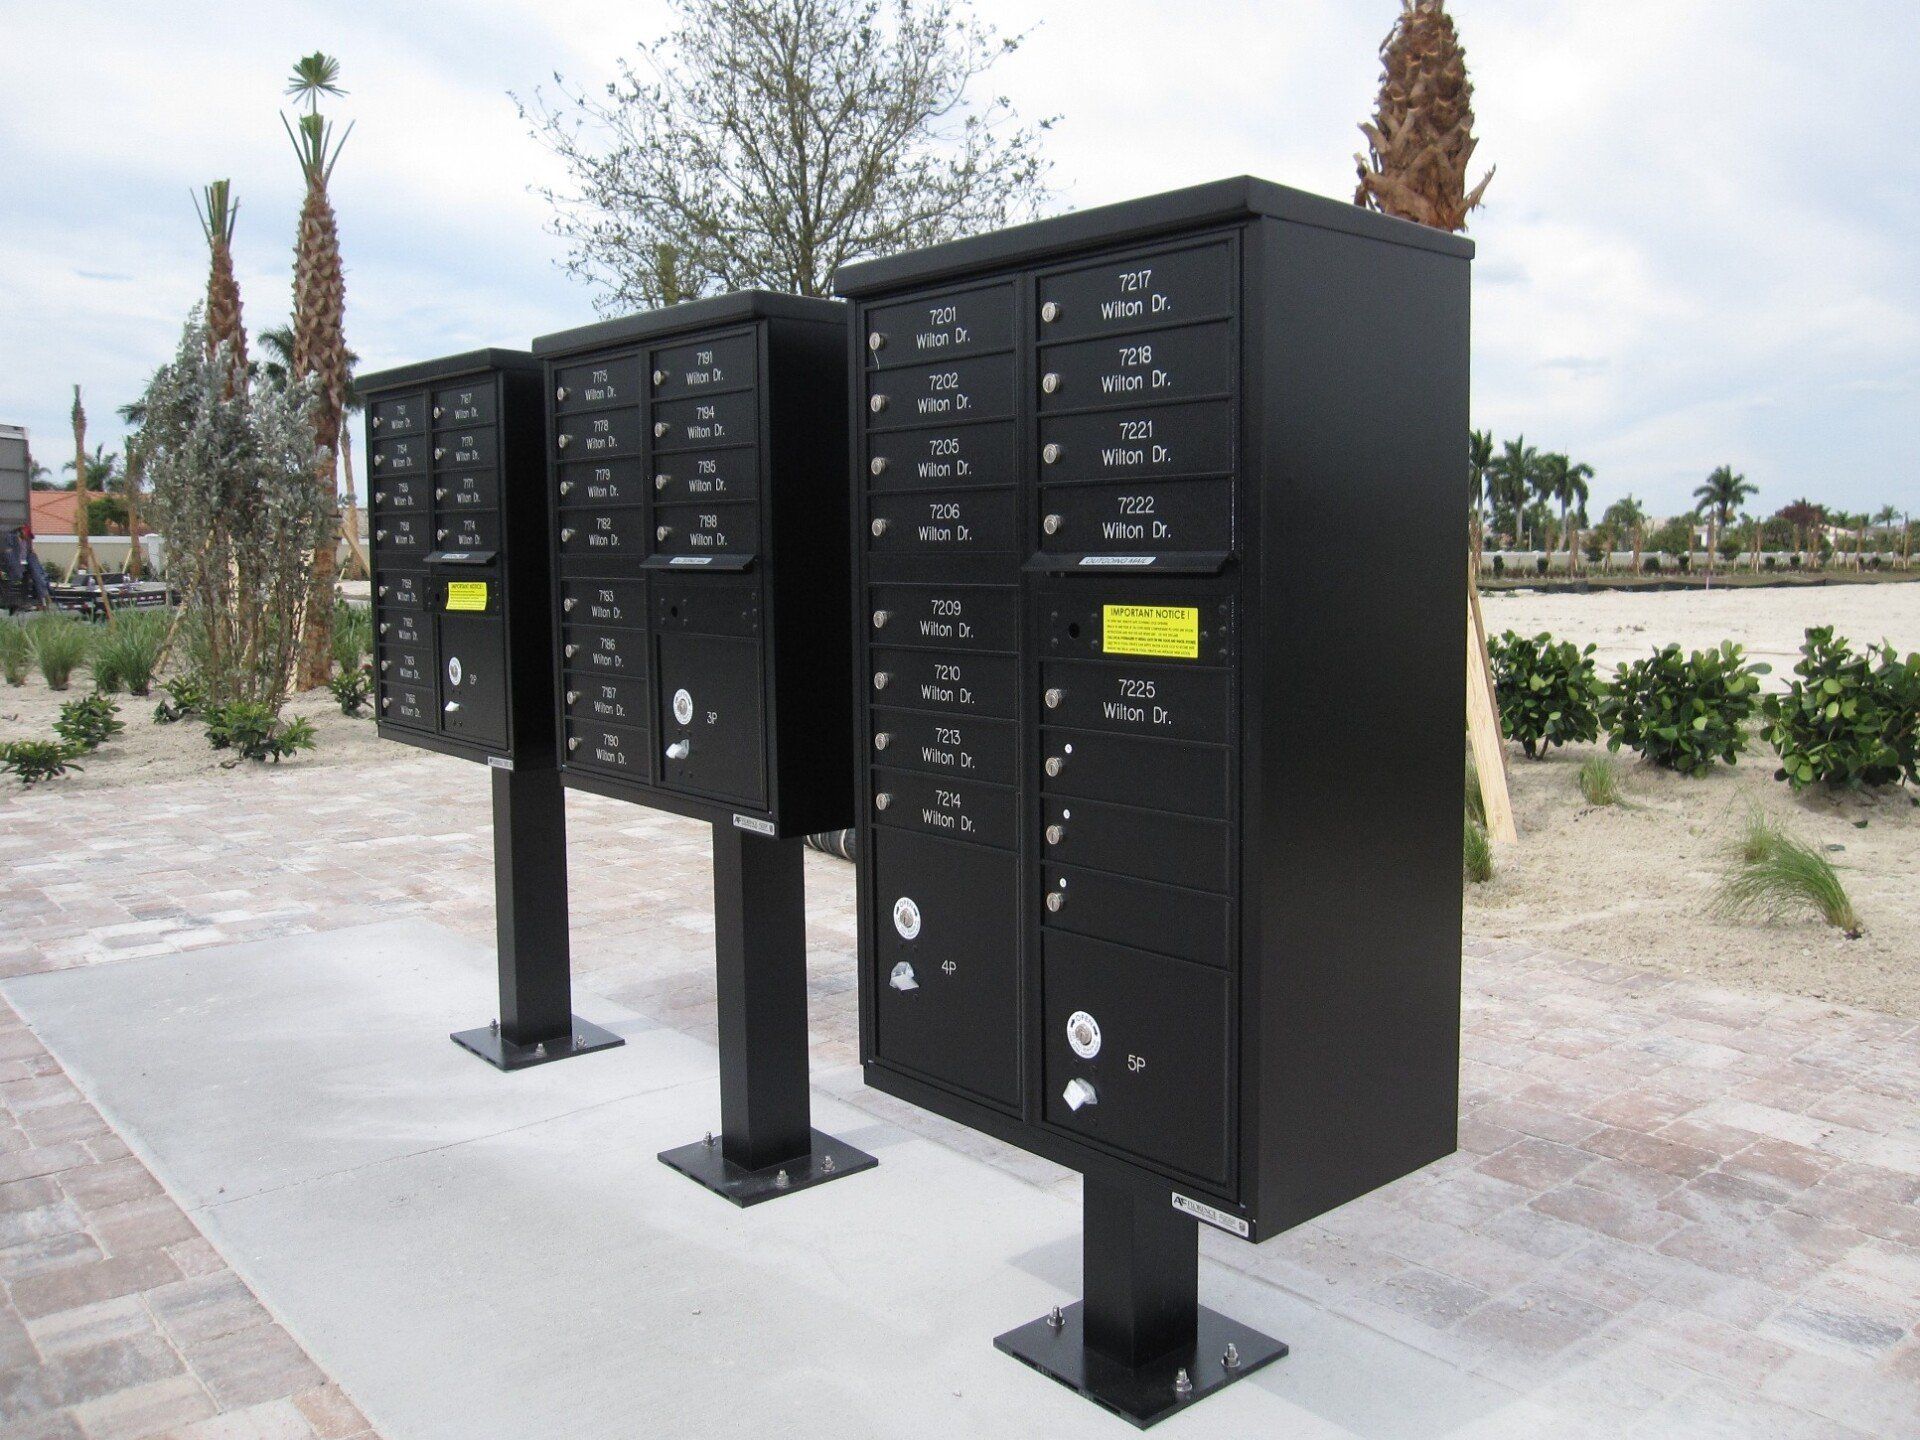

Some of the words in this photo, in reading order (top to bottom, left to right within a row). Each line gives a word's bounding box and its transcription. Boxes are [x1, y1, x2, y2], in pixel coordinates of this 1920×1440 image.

[1119, 270, 1152, 292] 7217
[1101, 300, 1143, 320] Wilton
[1152, 295, 1171, 312] Dr.
[929, 306, 956, 325] 7201
[917, 330, 949, 349] Wilton
[955, 328, 970, 343] Dr.
[697, 351, 712, 365] 7191
[1119, 346, 1152, 367] 7218
[593, 370, 607, 383] 7175
[686, 371, 709, 385] Wilton
[713, 368, 723, 381] Dr.
[929, 372, 958, 390] 7202
[1101, 375, 1143, 394] Wilton
[1152, 370, 1171, 388] Dr.
[585, 389, 604, 400] Wilton
[608, 386, 616, 398] Dr.
[918, 397, 950, 413] Wilton
[957, 394, 971, 410] Dr.
[696, 406, 714, 419] 7194
[594, 420, 608, 432] 7178
[688, 426, 710, 439] Wilton
[714, 424, 725, 436] Dr.
[1119, 421, 1152, 440] 7221
[586, 437, 605, 449] Wilton
[608, 436, 617, 447] Dr.
[929, 439, 959, 455] 7205
[1102, 448, 1143, 467] Wilton
[1152, 445, 1171, 463] Dr.
[595, 469, 610, 481] 7179
[698, 461, 716, 474] 7195
[918, 461, 951, 478] Wilton
[957, 460, 972, 476] Dr.
[588, 486, 607, 498] Wilton
[610, 486, 618, 496] Dr.
[689, 480, 711, 492] Wilton
[716, 479, 726, 491] Dr.
[930, 504, 960, 519] 7206
[1118, 496, 1154, 515] 7222
[597, 518, 611, 529] 7182
[699, 515, 717, 528] 7198
[918, 526, 951, 541] Wilton
[957, 526, 972, 541] Dr.
[1102, 521, 1143, 540] Wilton
[1152, 521, 1171, 539] Dr.
[589, 534, 608, 545] Wilton
[611, 534, 620, 546] Dr.
[690, 534, 712, 546] Wilton
[717, 534, 727, 546] Dr.
[599, 590, 613, 602] 7183
[591, 606, 610, 618] Wilton
[614, 607, 622, 619] Dr.
[931, 600, 961, 617] 7209
[1111, 608, 1153, 618] IMPORTANT
[1156, 610, 1185, 619] NOTICE
[920, 621, 953, 638] Wilton
[958, 622, 974, 639] Dr.
[600, 638, 615, 650] 7186
[593, 653, 612, 666] Wilton
[615, 655, 623, 667] Dr.
[934, 665, 960, 681] 7210
[602, 686, 616, 698] 7187
[921, 684, 954, 702] Wilton
[960, 688, 974, 704] Dr.
[1118, 679, 1155, 698] 7225
[594, 701, 613, 714] Wilton
[616, 704, 625, 716] Dr.
[1103, 702, 1144, 722] Wilton
[1153, 707, 1171, 724] Dr.
[707, 712, 717, 724] 3P
[603, 734, 618, 746] 7190
[935, 728, 961, 745] 7213
[596, 748, 615, 762] Wilton
[618, 752, 626, 765] Dr.
[922, 748, 954, 766] Wilton
[960, 752, 975, 768] Dr.
[935, 790, 961, 808] 7214
[922, 809, 955, 830] Wilton
[961, 815, 975, 832] Dr.
[942, 960, 956, 975] 4P
[1128, 1054, 1145, 1072] 5P
